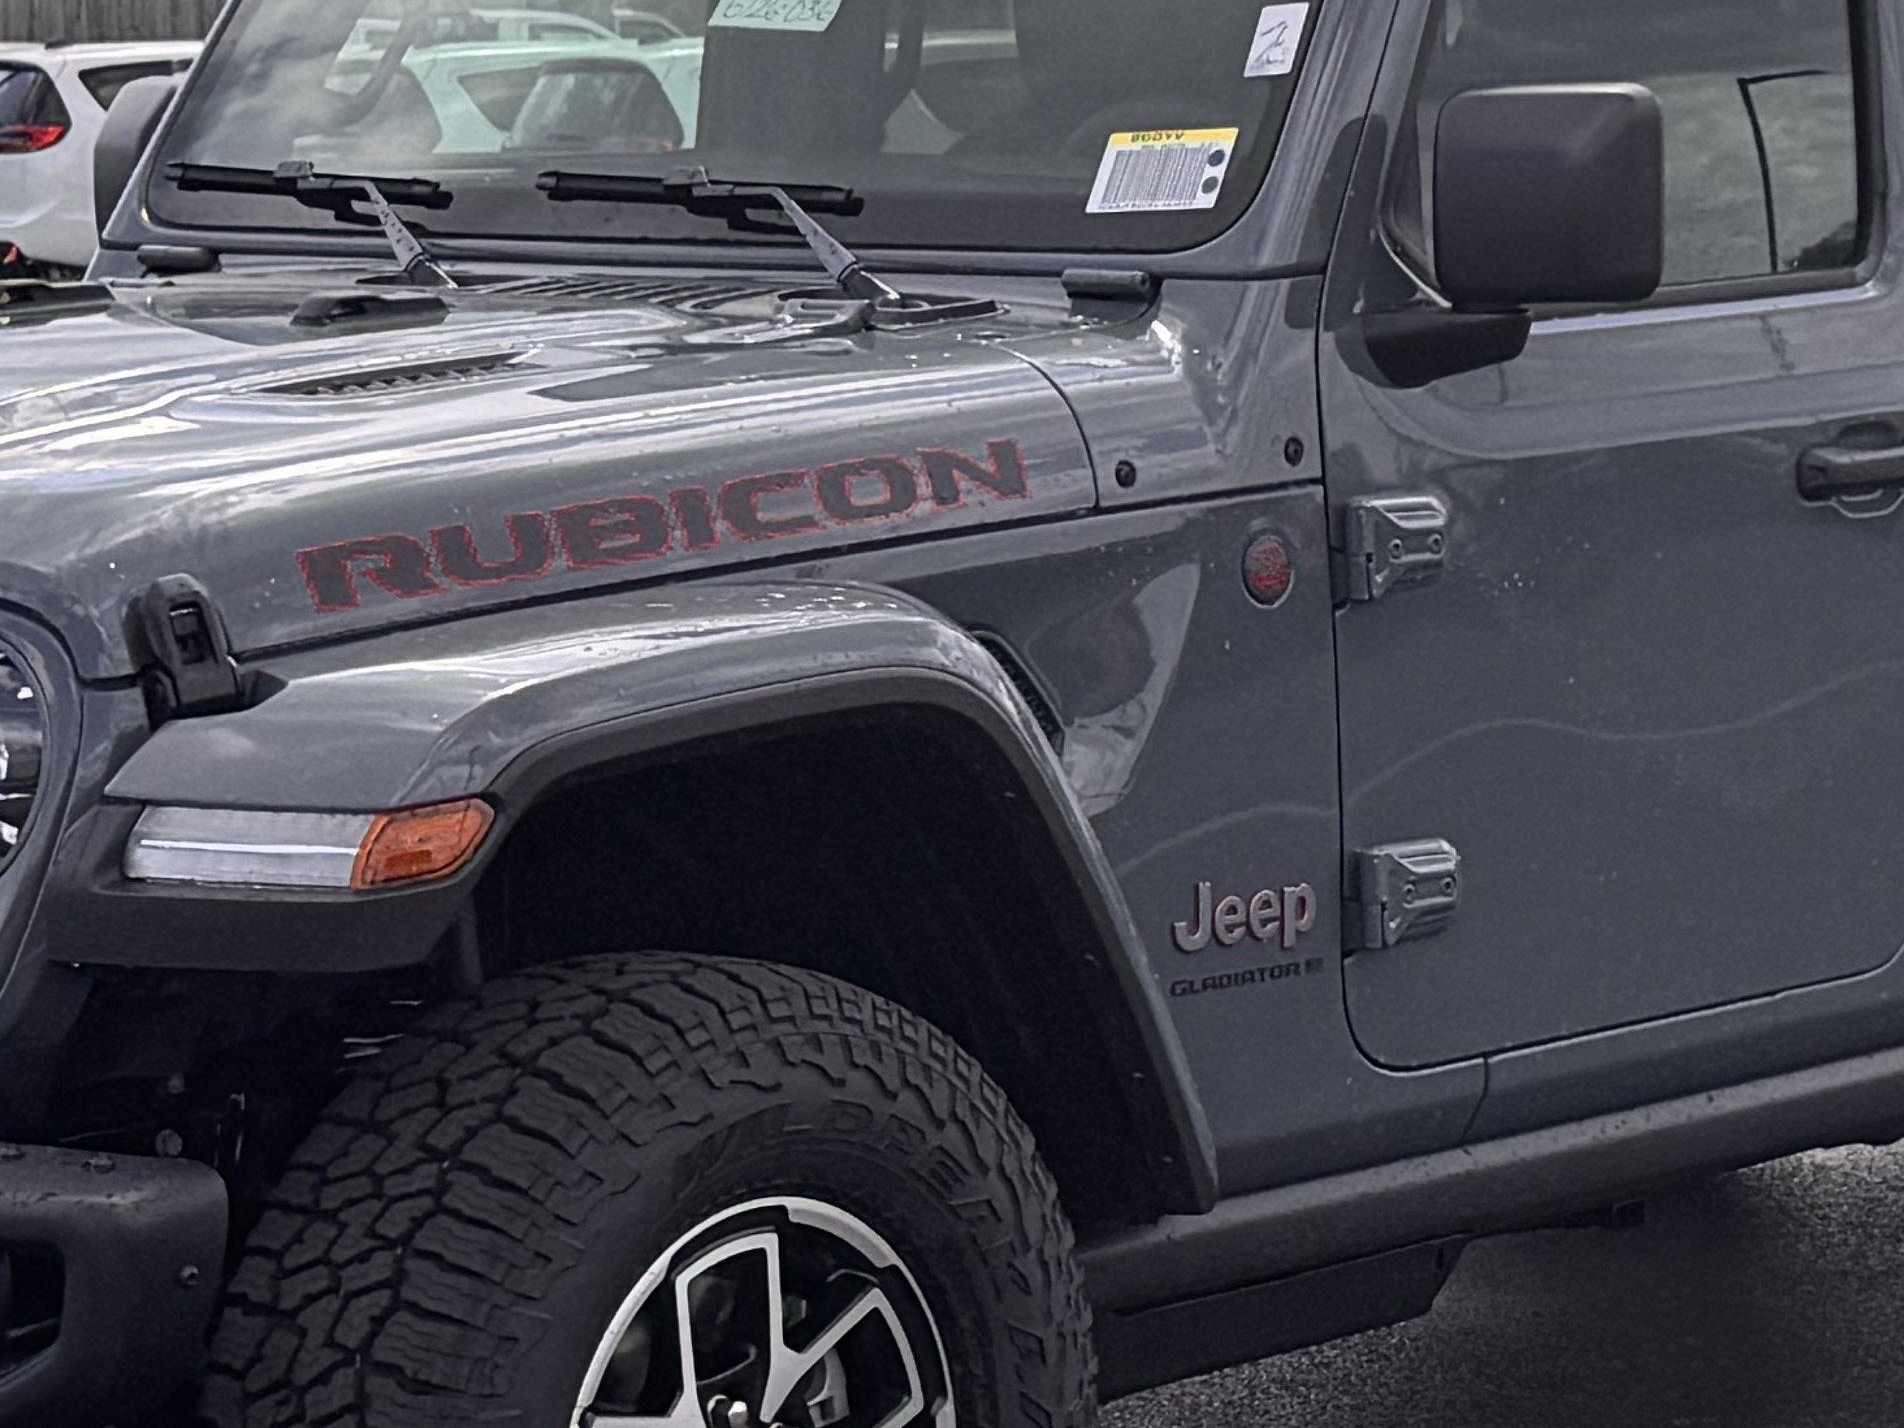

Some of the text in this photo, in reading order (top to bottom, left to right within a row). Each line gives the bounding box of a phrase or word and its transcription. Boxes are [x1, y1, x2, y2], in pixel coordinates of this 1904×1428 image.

[296, 438, 1030, 613] RUBICON
[1172, 881, 1317, 953] Jeep
[1169, 962, 1302, 998] GLADIATOR
